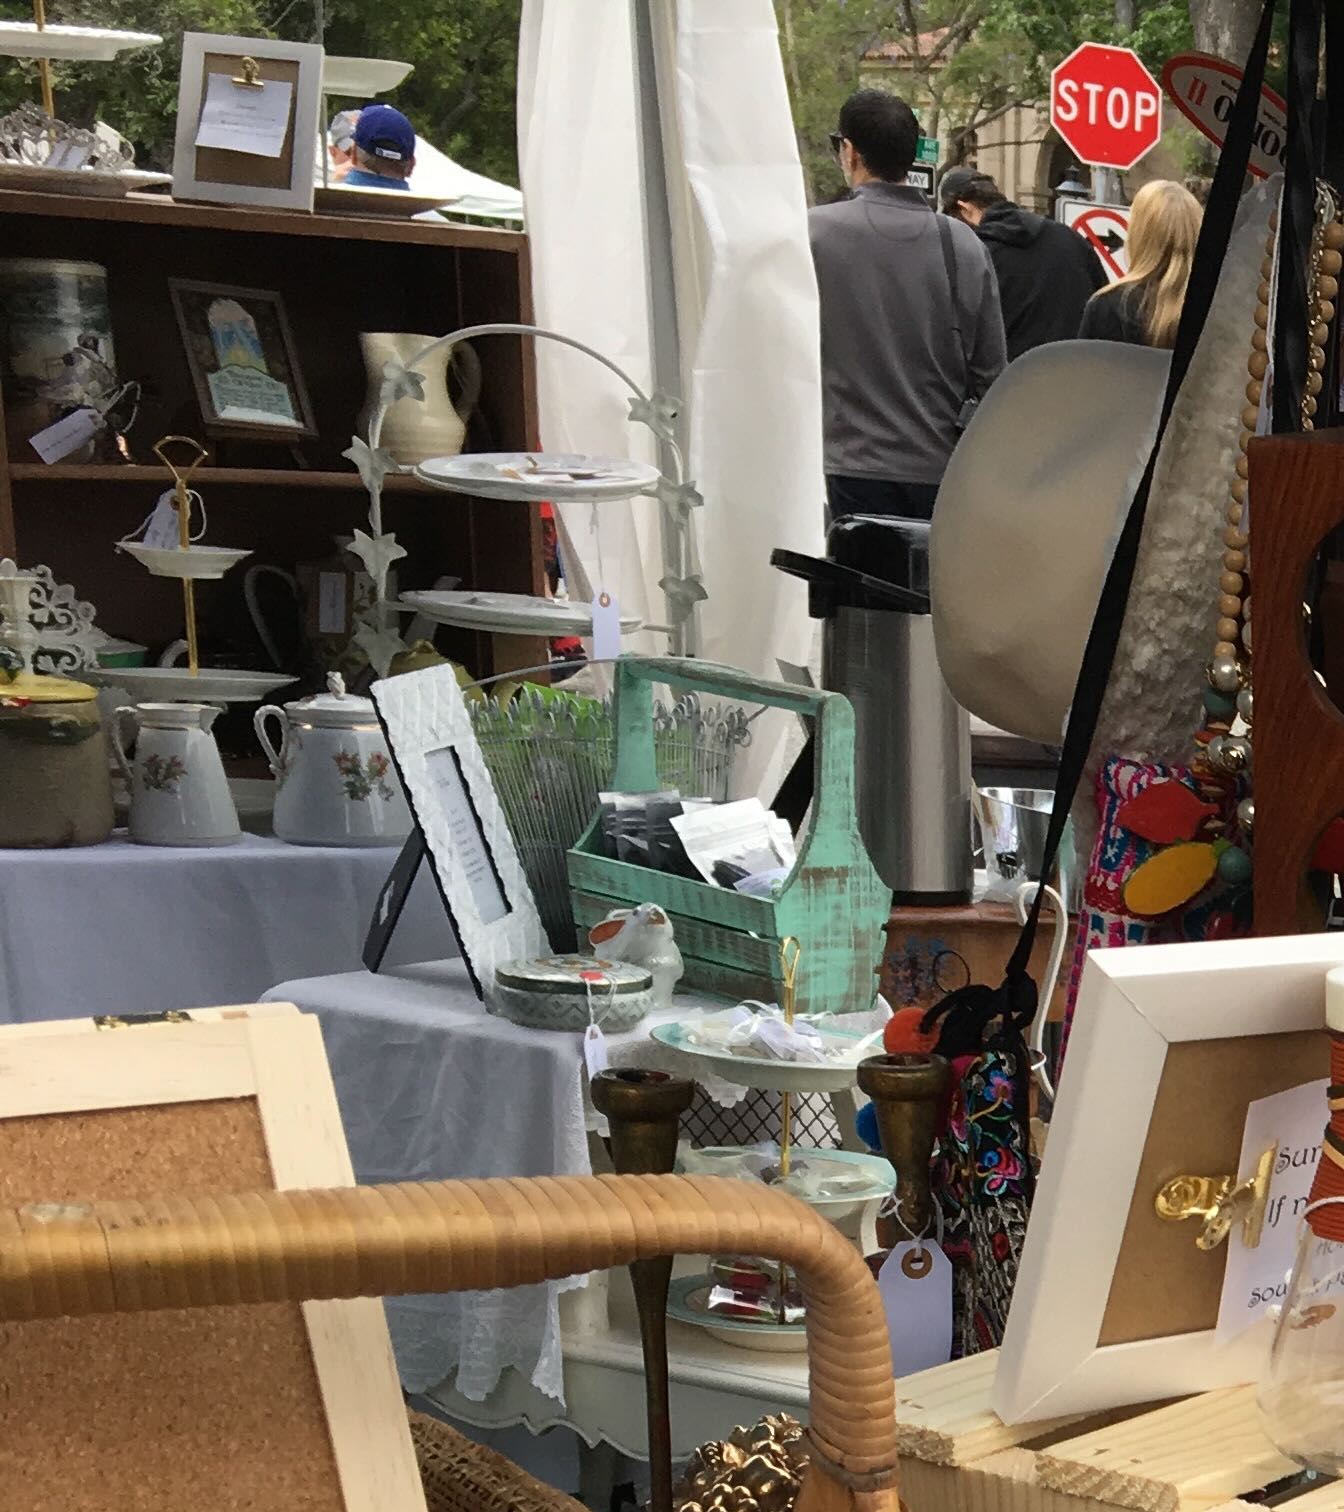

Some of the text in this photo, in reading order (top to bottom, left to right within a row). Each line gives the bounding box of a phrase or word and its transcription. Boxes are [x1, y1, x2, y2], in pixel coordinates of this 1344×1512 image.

[1055, 78, 1157, 132] STOP
[1274, 1145, 1323, 1174] Sur
[1267, 1195, 1287, 1229] If
